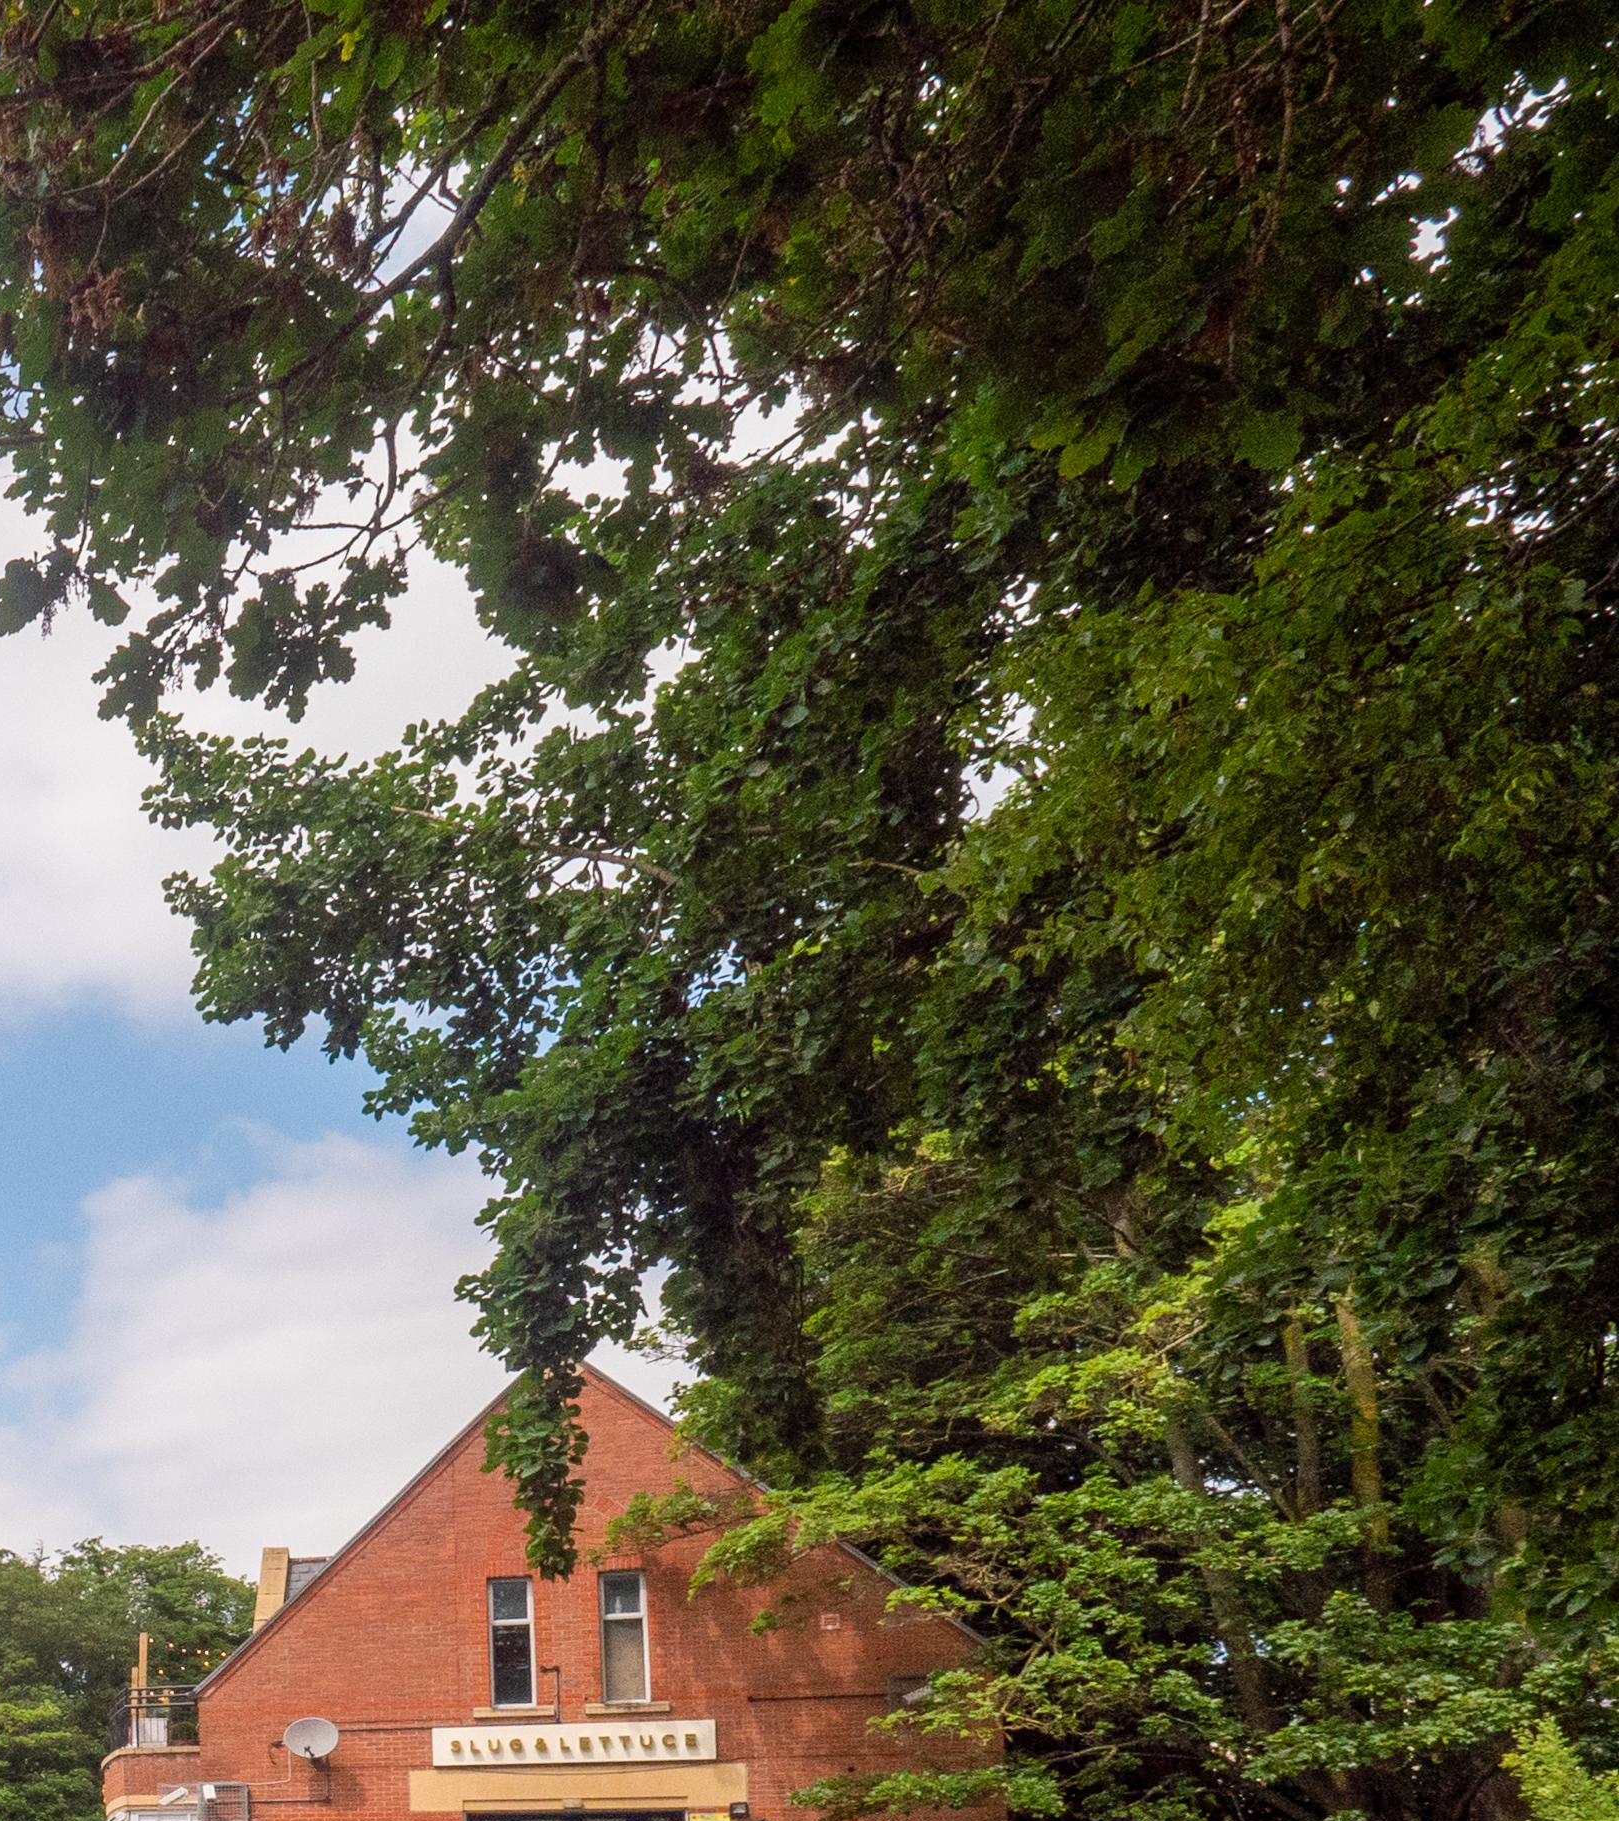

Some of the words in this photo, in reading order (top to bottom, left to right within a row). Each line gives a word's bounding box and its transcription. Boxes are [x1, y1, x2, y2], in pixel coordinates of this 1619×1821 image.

[449, 1738, 522, 1753] SLUG
[534, 1737, 547, 1751] &
[559, 1733, 697, 1751] LETTUCE
